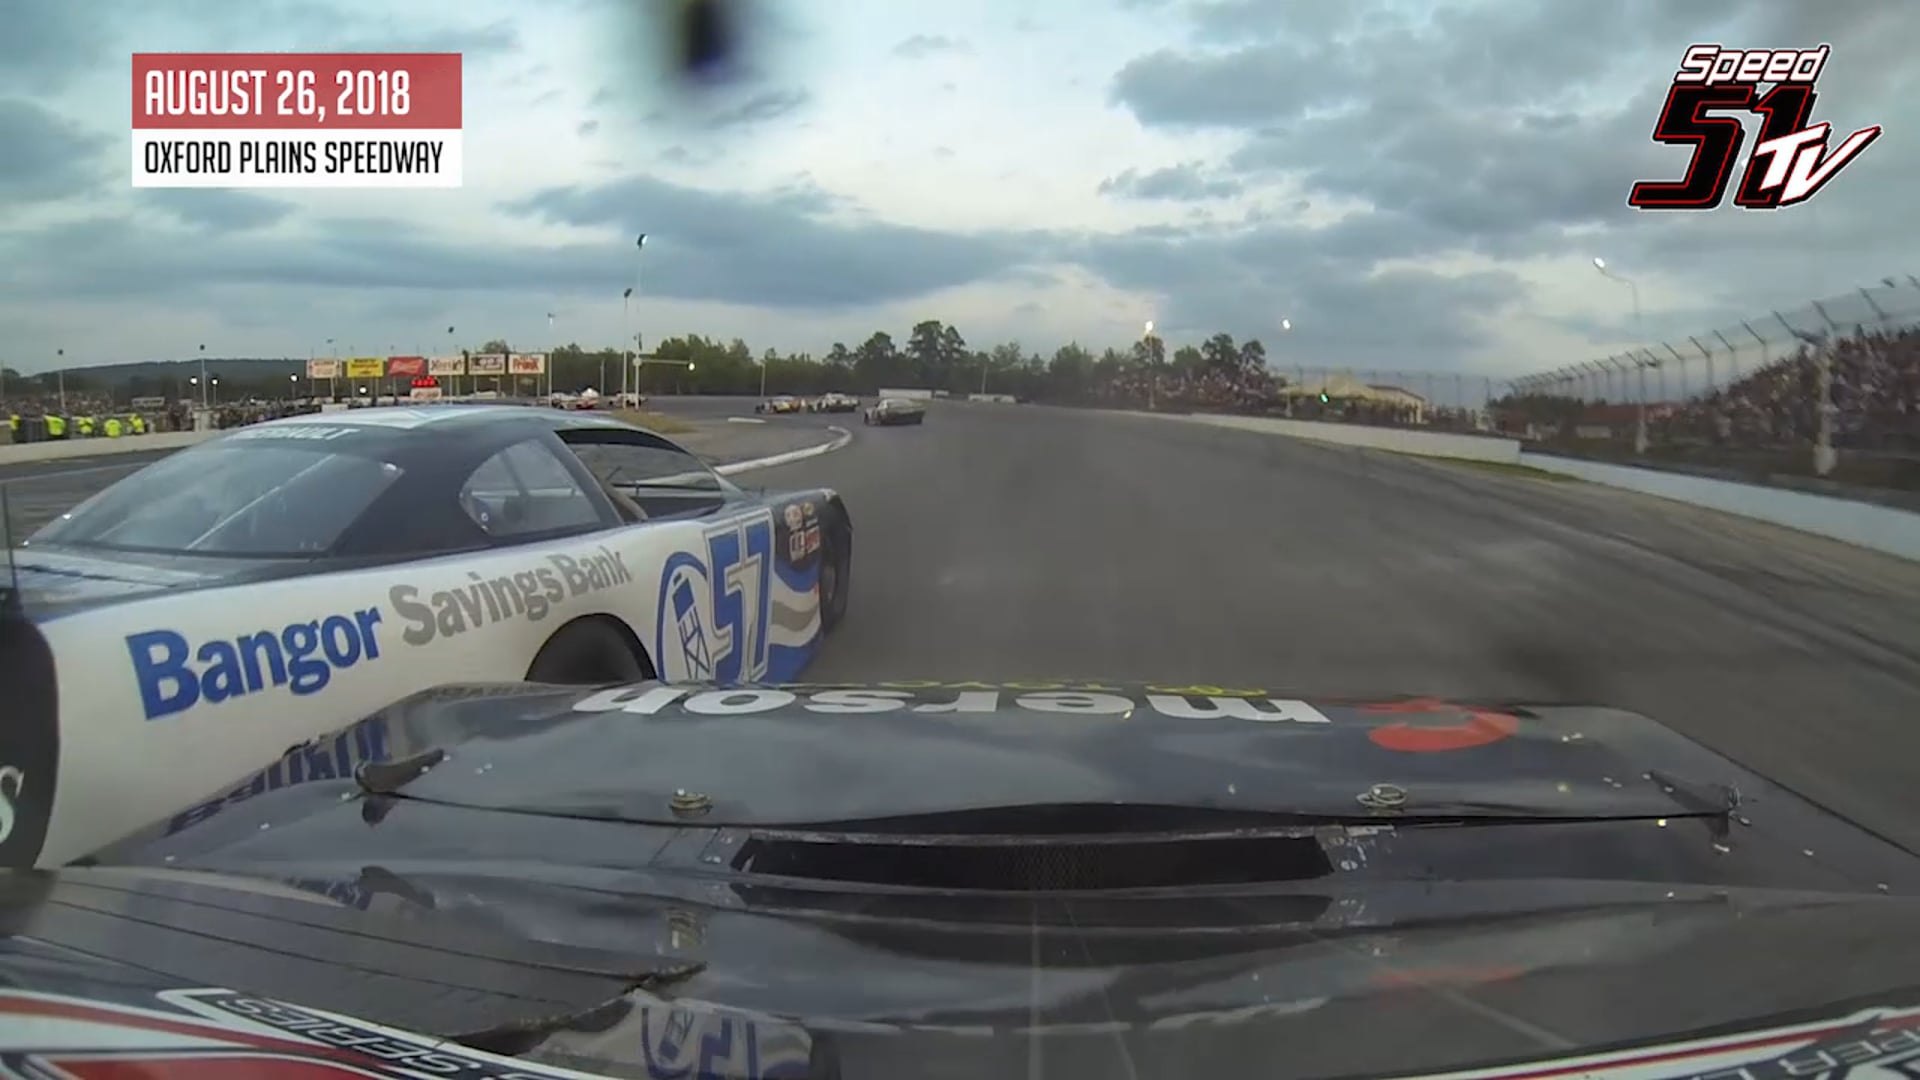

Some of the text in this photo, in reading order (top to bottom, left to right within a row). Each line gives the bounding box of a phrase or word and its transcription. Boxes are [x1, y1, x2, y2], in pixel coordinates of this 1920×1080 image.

[125, 546, 635, 721] Bangor Savings Bank
[703, 507, 775, 684] 57
[217, 997, 481, 1074] SERIES
